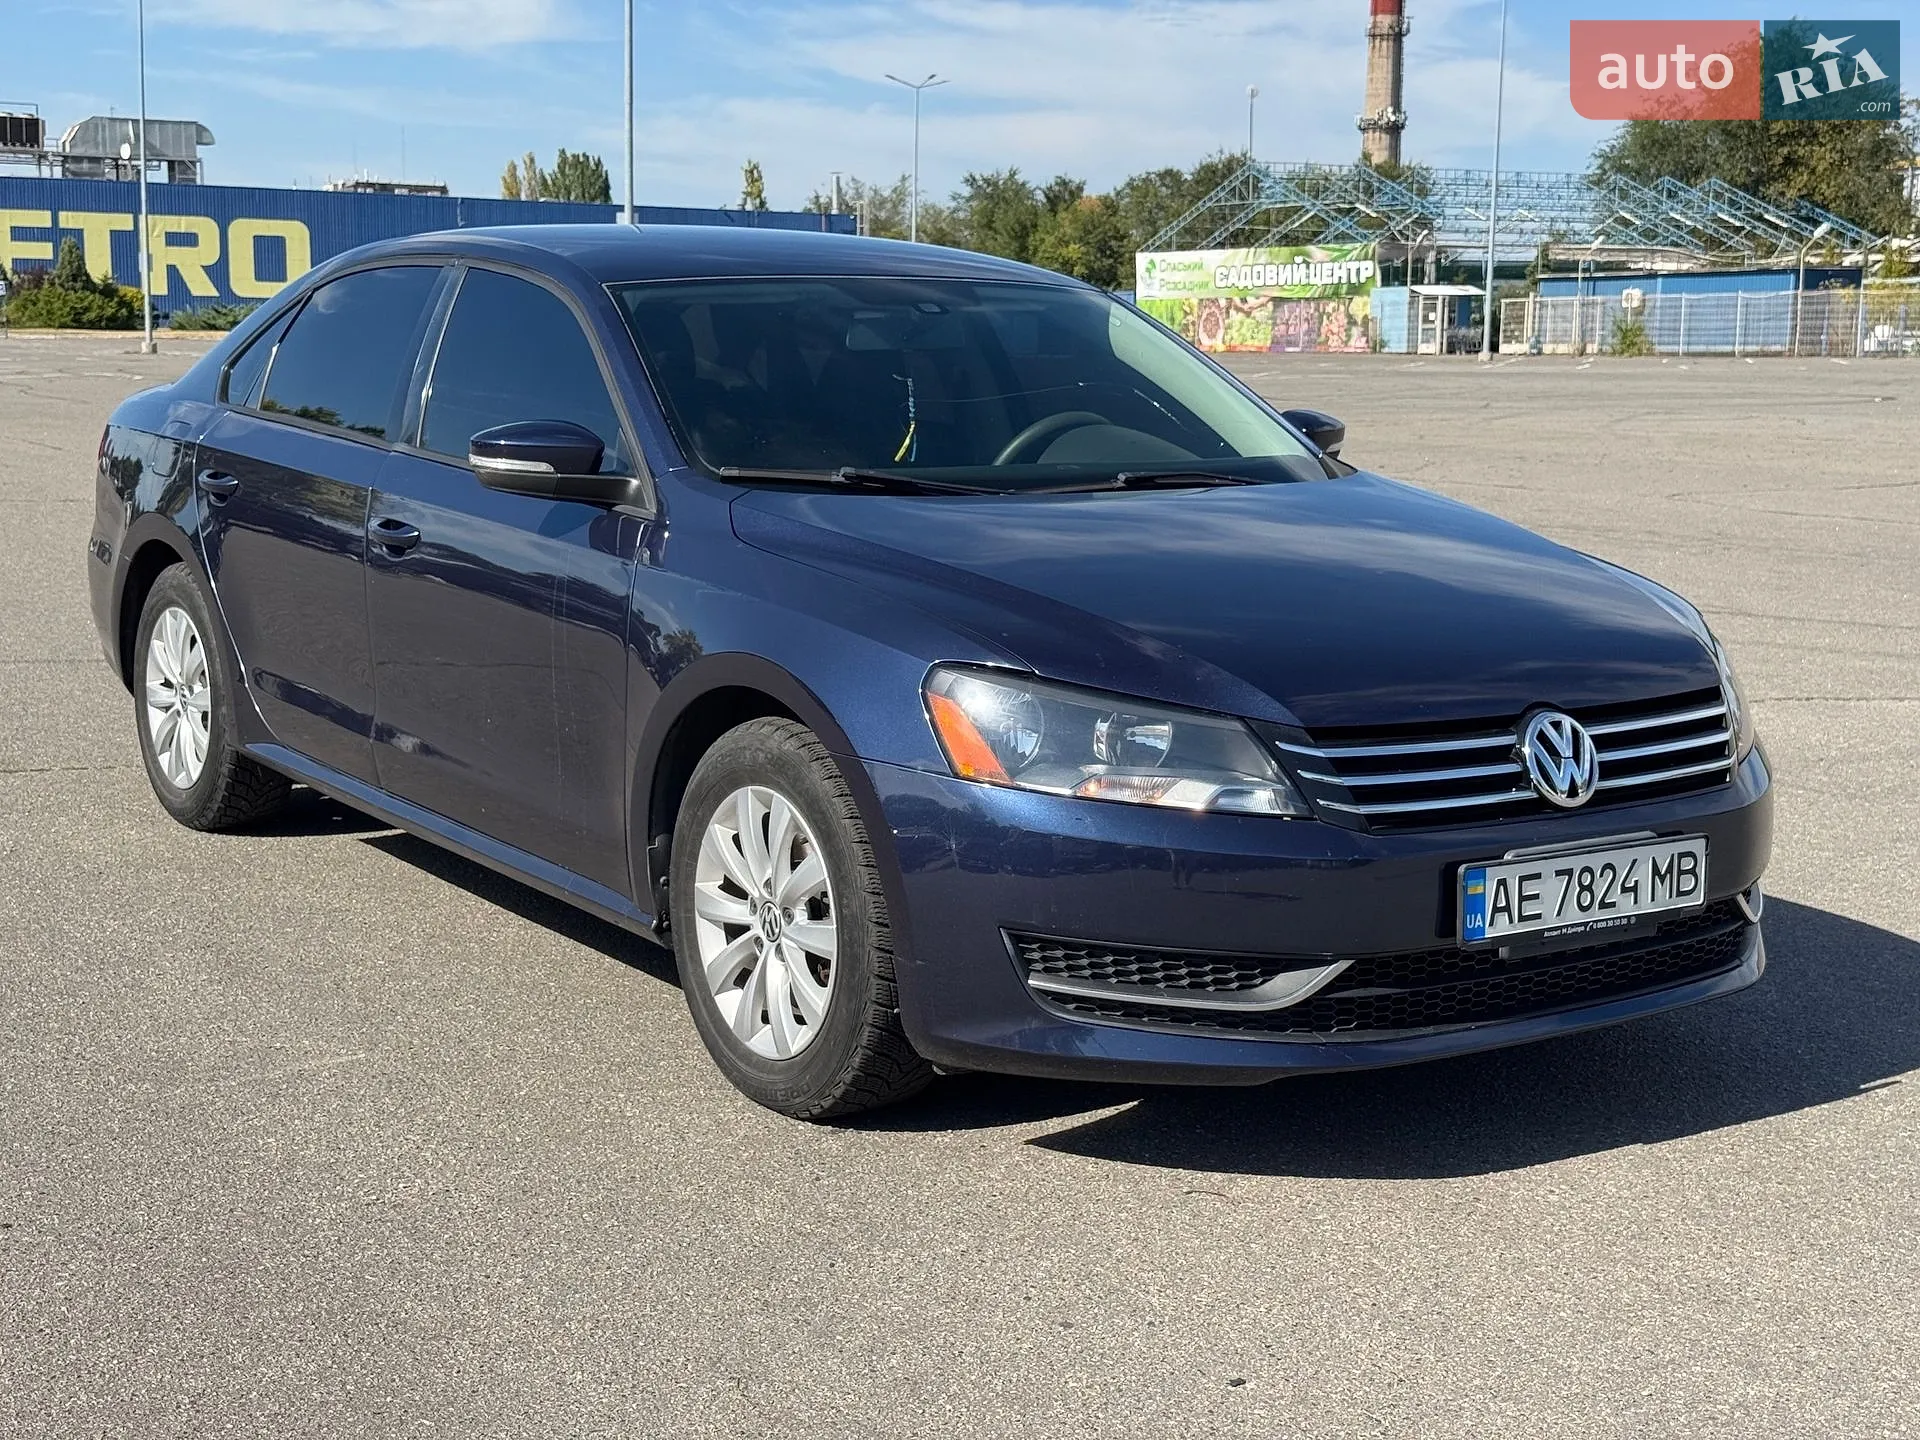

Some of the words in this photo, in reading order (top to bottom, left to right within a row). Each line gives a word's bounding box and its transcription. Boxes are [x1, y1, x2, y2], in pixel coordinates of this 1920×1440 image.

[1308, 260, 1375, 286] ЦЕНТР
[1487, 872, 1543, 928] AE
[1553, 858, 1639, 919] 7824
[1649, 850, 1699, 904] MB
[1466, 913, 1484, 929] UA
